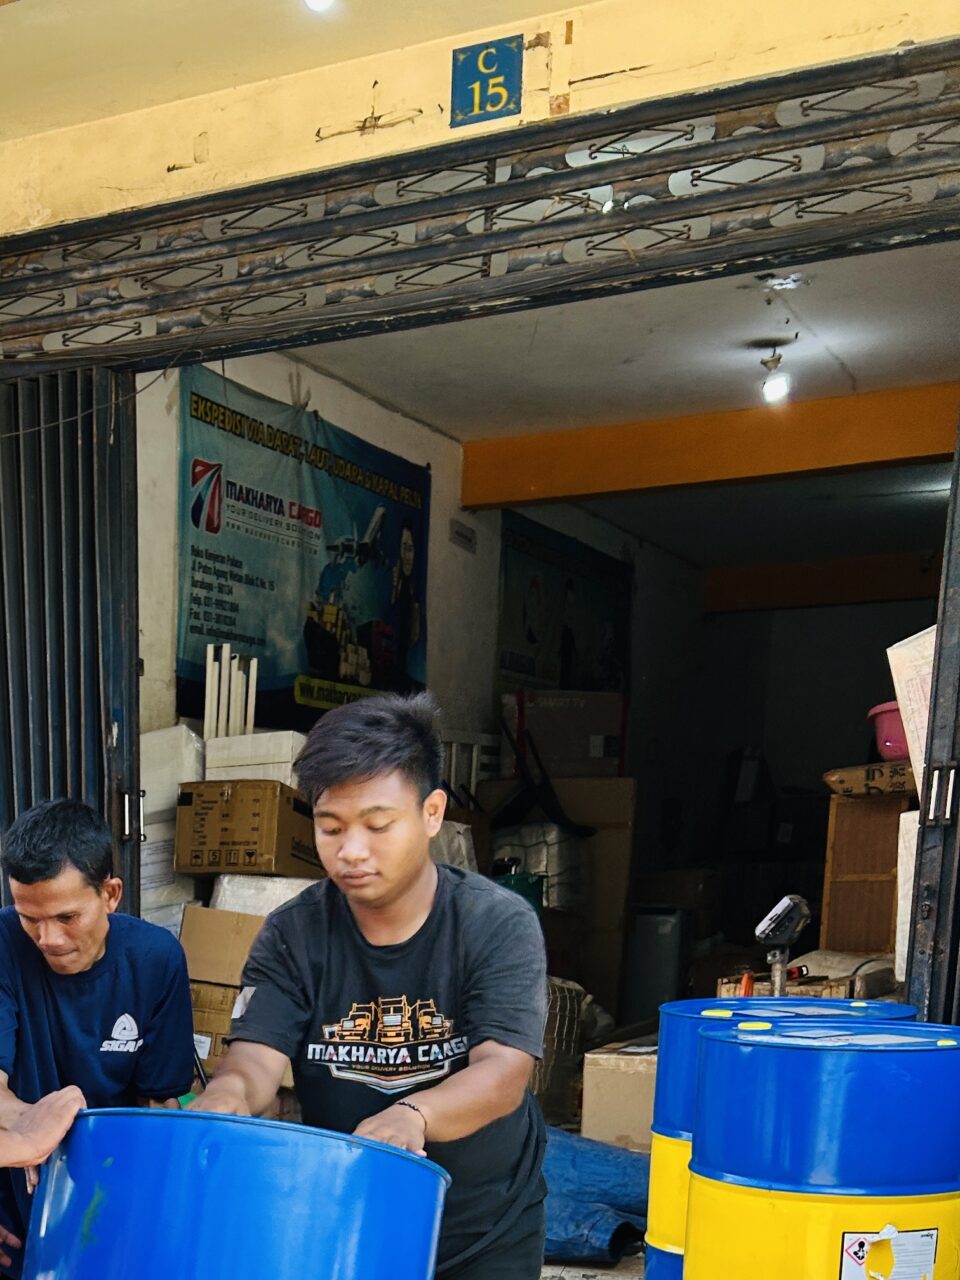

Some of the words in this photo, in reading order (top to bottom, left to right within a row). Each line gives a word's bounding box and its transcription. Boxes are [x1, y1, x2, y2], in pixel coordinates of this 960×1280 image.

[477, 48, 498, 74] C
[467, 75, 509, 117] 15
[190, 392, 246, 439] EKSPEDISI
[226, 480, 286, 517] MAKHARYA
[100, 1039, 144, 1052] SIGAP
[307, 1043, 411, 1064] MAKHARYA
